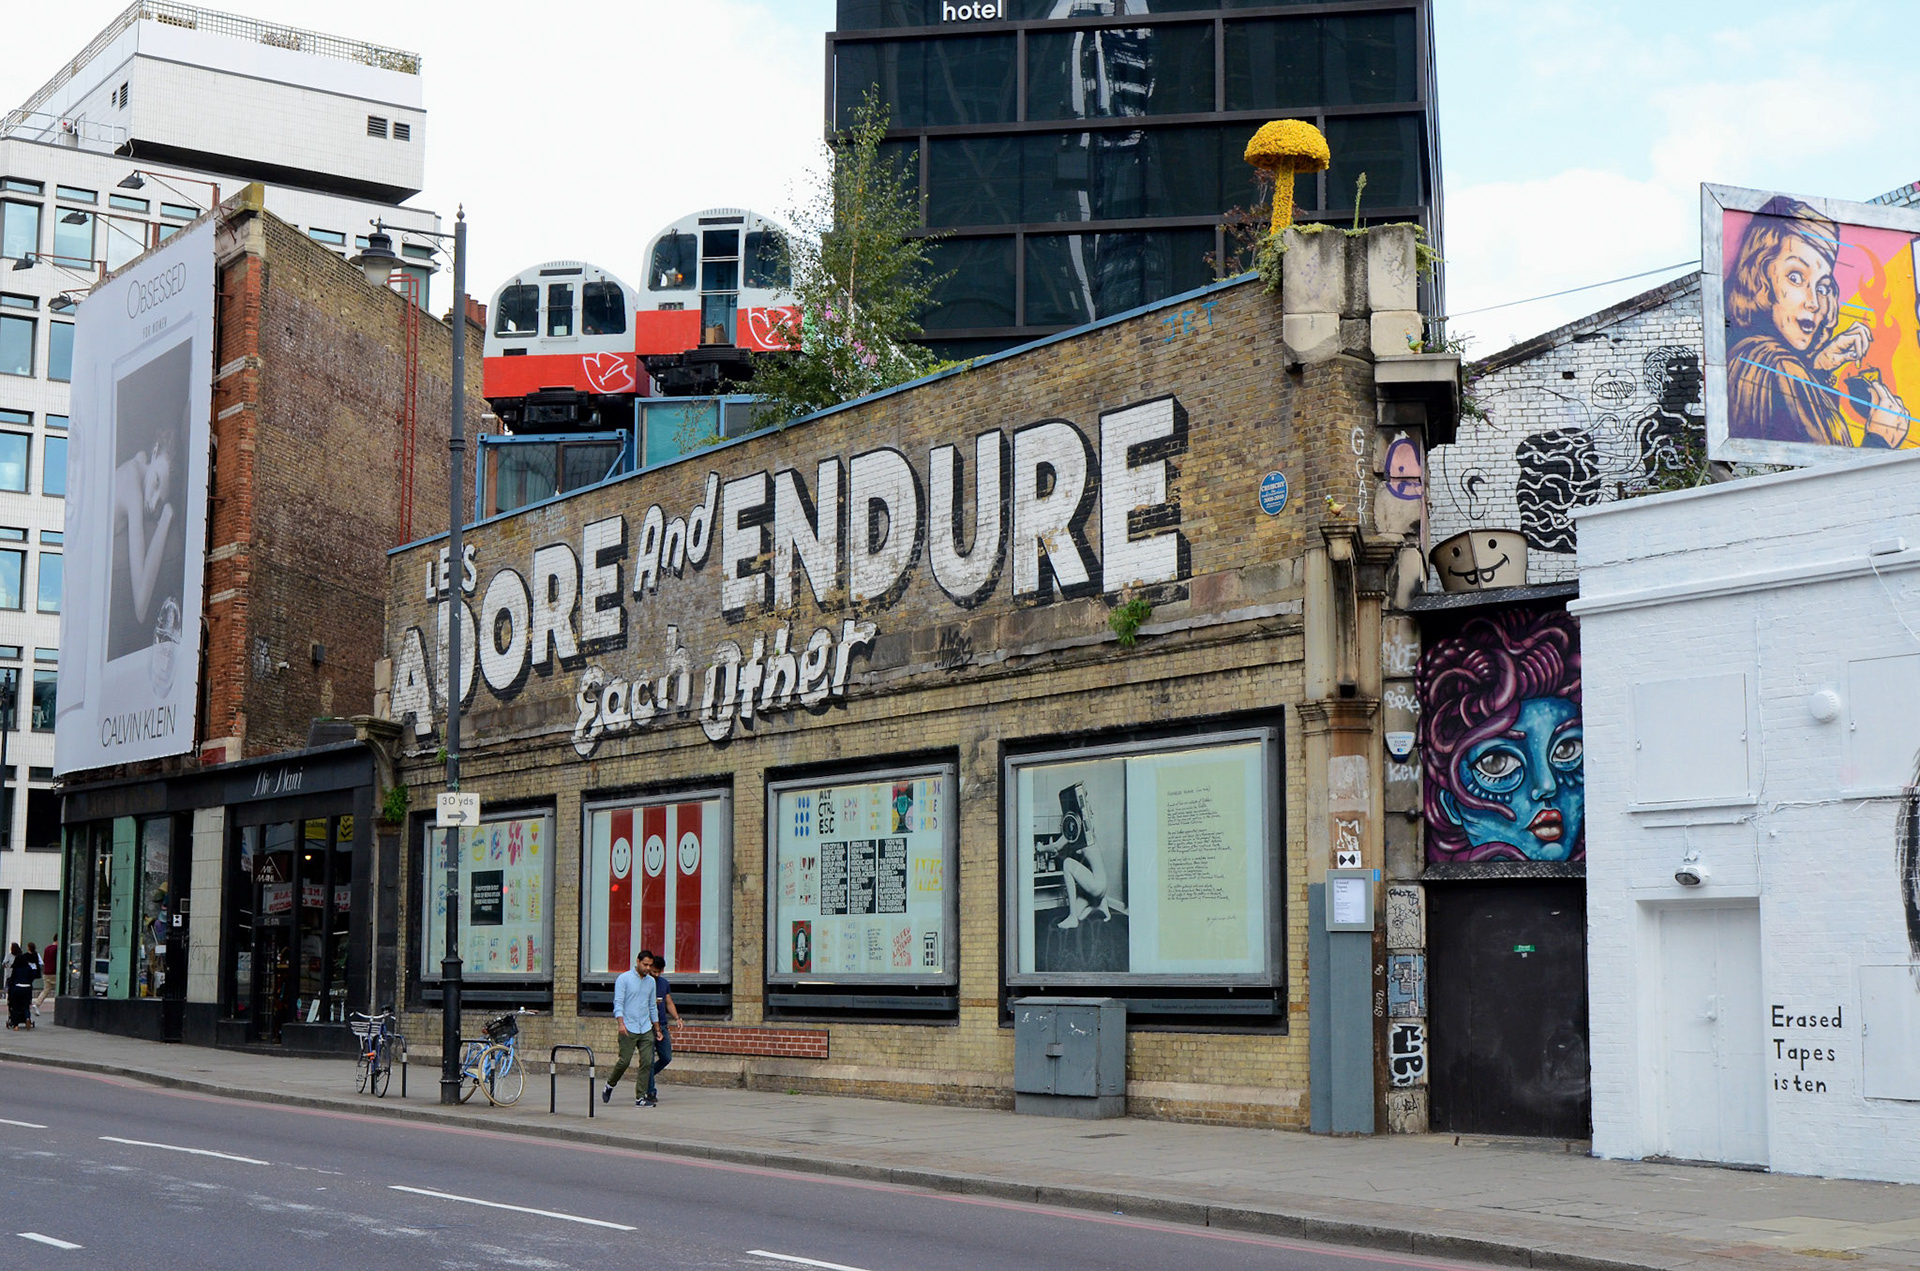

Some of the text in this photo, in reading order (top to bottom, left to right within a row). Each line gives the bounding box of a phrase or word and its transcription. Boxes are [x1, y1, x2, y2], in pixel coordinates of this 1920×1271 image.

[943, 0, 1002, 21] hotel
[1162, 301, 1219, 343] JET
[390, 514, 626, 738] ADORE
[722, 394, 1190, 624] ENDURE
[101, 704, 177, 748] CALVIN KLEIN
[442, 797, 474, 807] 30 yds
[819, 817, 835, 834] ESC
[1771, 1004, 1842, 1028] Erased
[1773, 1038, 1835, 1071] Tapes
